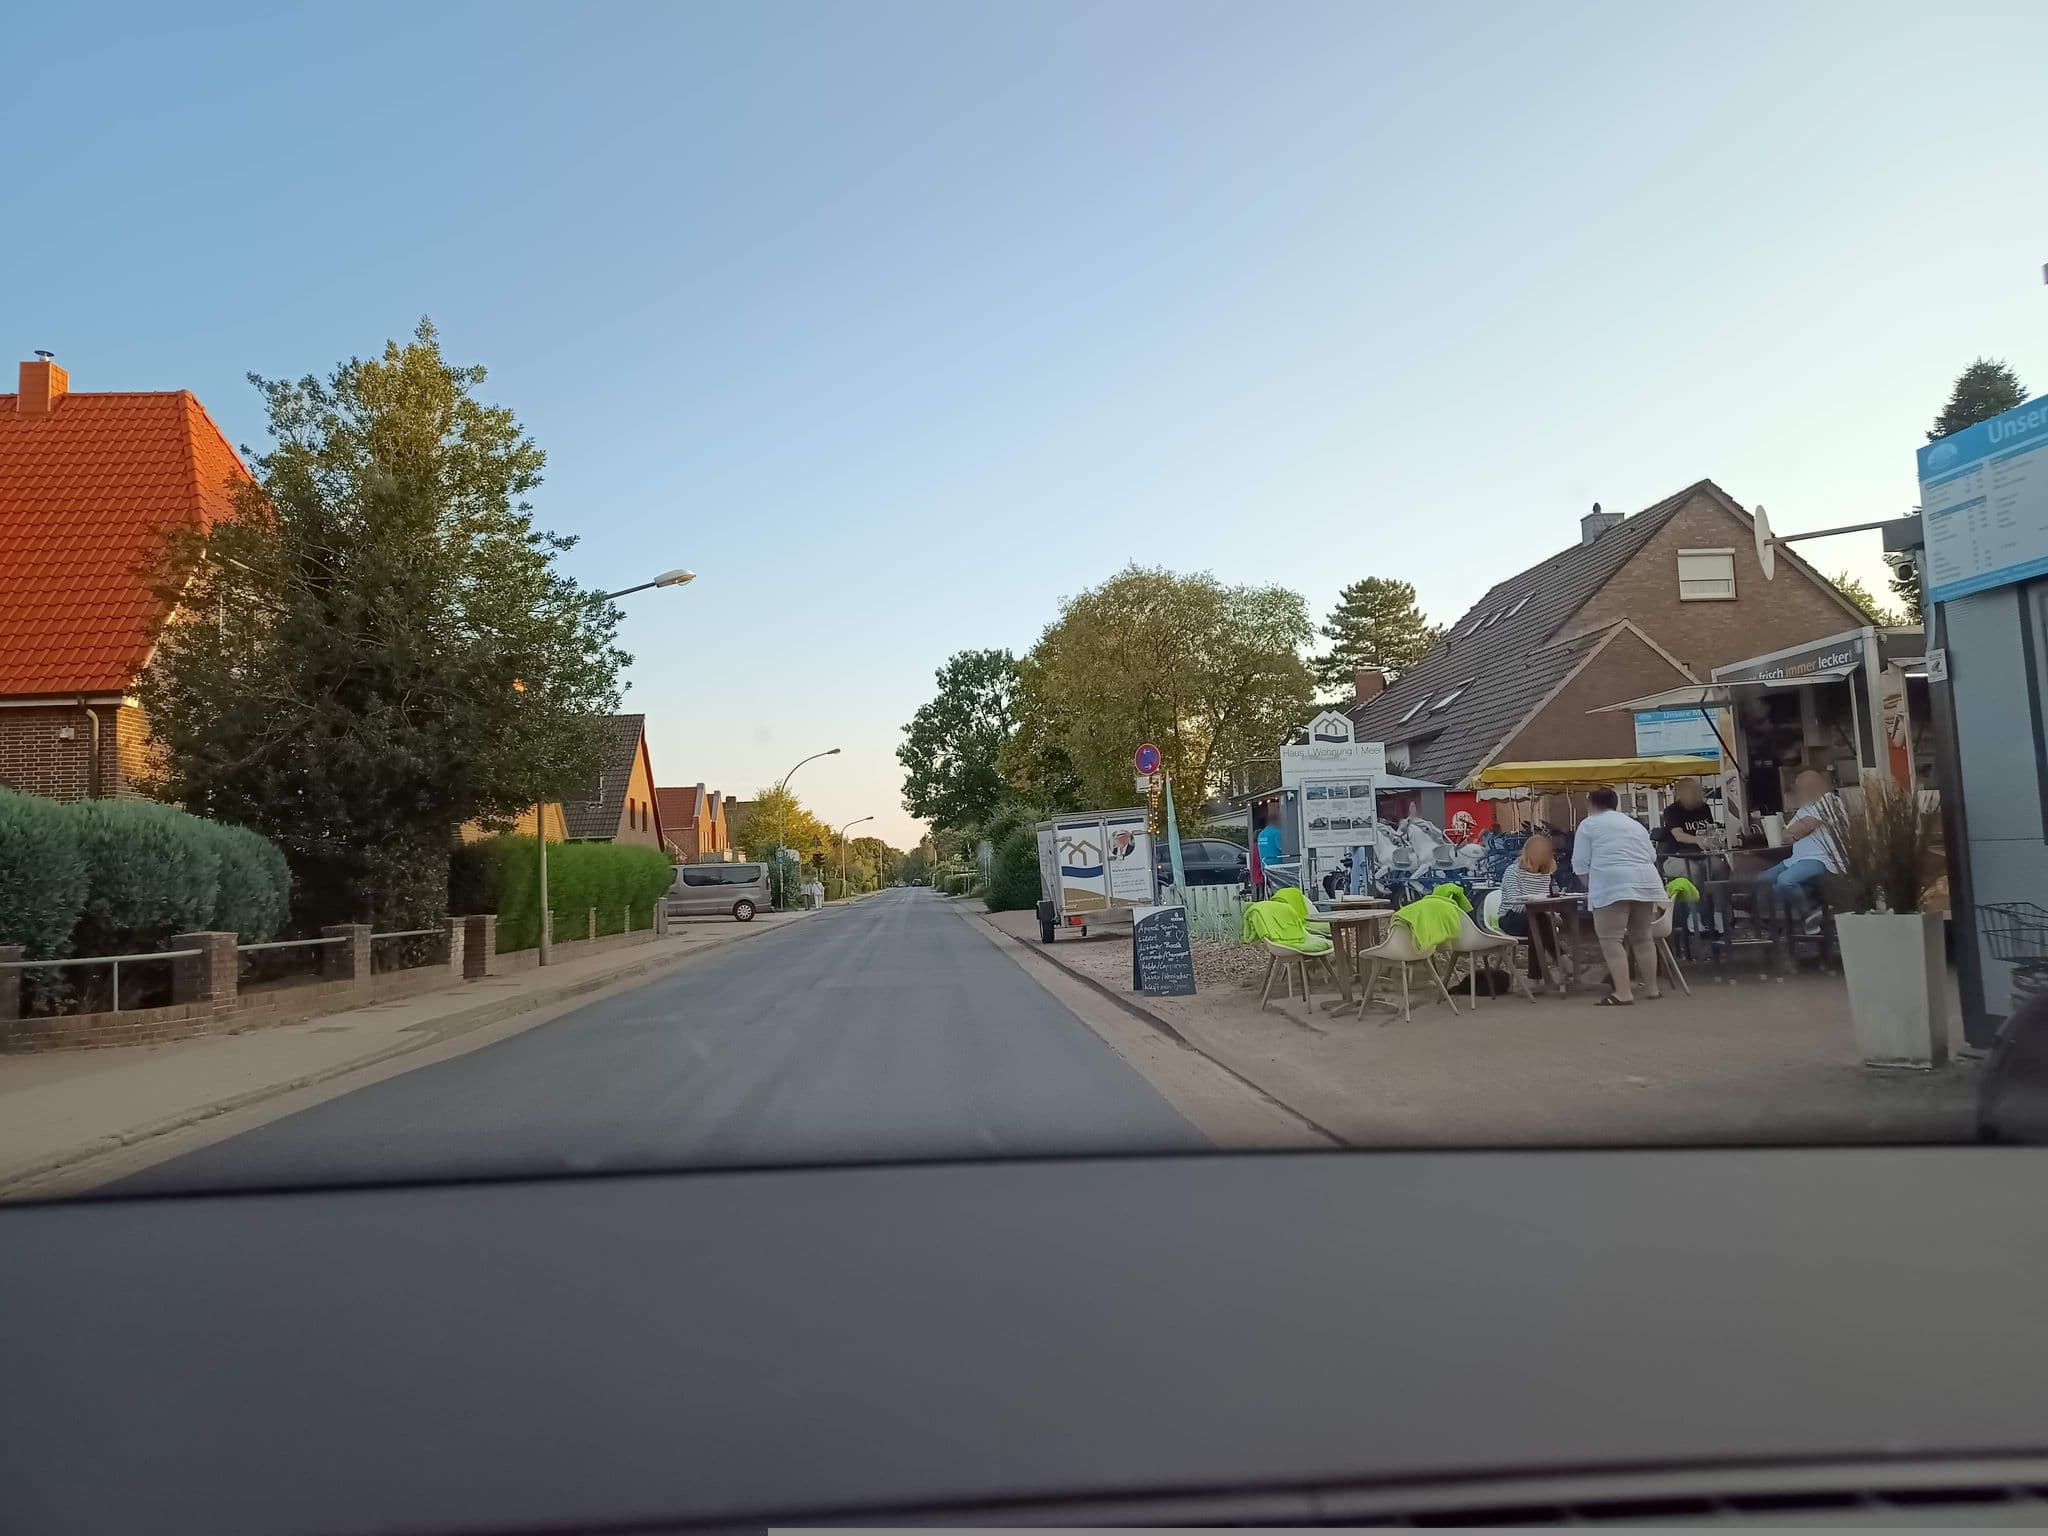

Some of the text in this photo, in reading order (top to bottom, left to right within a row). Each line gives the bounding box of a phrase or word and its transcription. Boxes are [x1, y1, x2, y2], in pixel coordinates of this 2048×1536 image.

[1785, 660, 1817, 678] immer
[1818, 650, 1853, 669] lecker!
[1283, 746, 1382, 758] Haus Wohnung Meer
